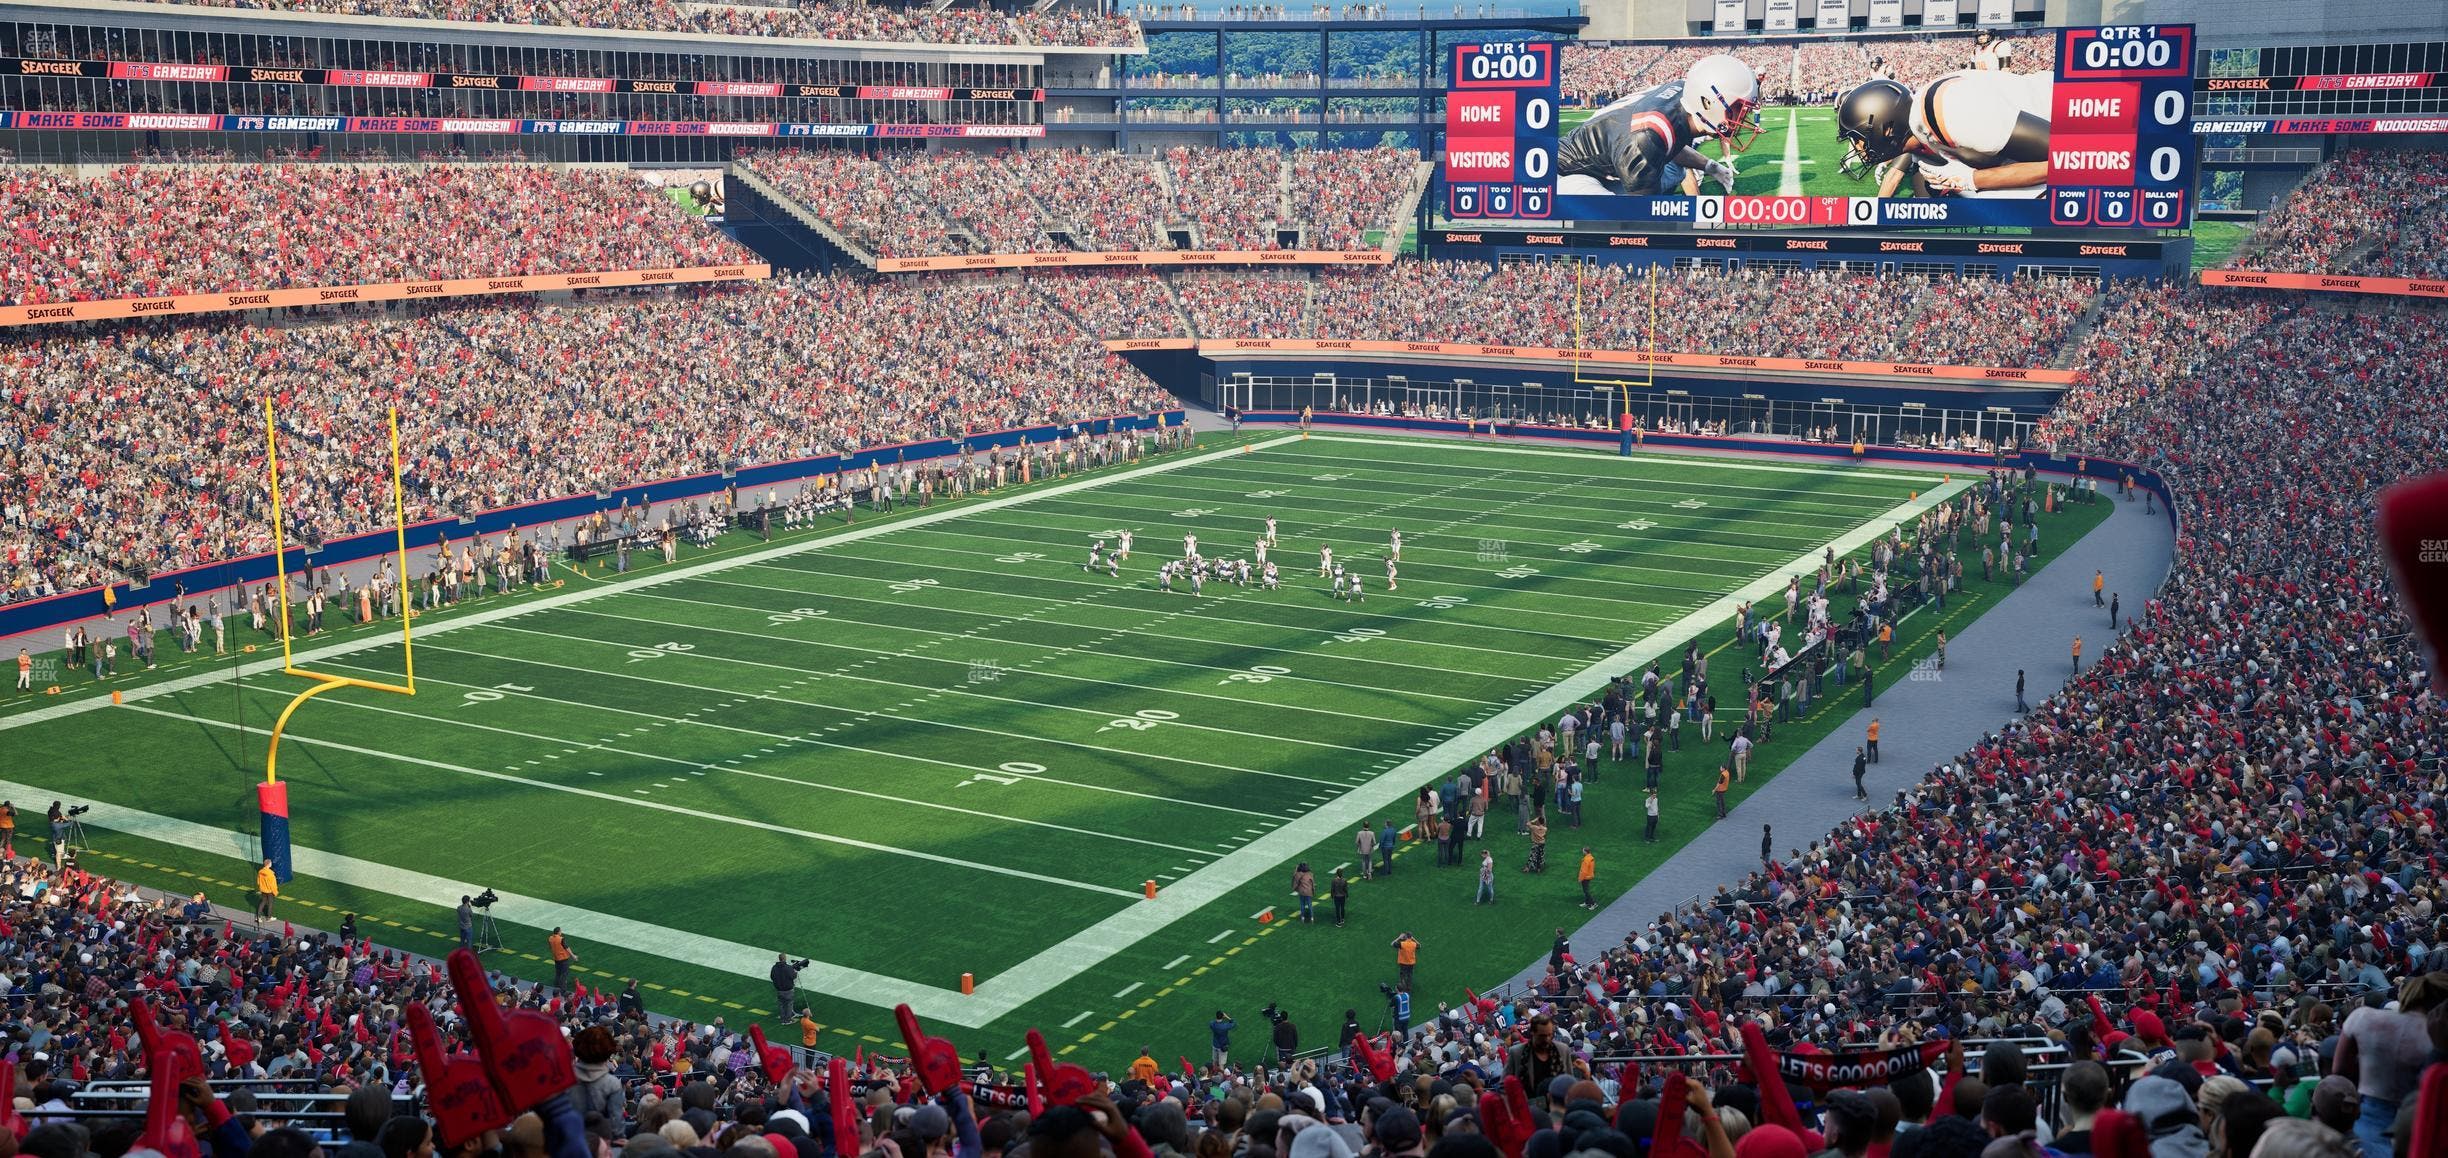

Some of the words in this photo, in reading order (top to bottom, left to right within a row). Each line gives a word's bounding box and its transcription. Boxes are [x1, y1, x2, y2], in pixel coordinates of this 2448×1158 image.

[2101, 27, 2140, 40] QTR
[2146, 26, 2156, 38] 1
[1483, 43, 1514, 54] QTR
[1518, 42, 1525, 53] 1
[2085, 39, 2171, 68] 0:00
[21, 61, 82, 76] SEATGEEK
[153, 66, 216, 79] GAMEDAY!
[1471, 54, 1537, 79] 0:00
[251, 69, 304, 82] SEATGEEK
[365, 73, 422, 85] GAMEDAY!
[452, 75, 499, 88] SEATGEEK
[2346, 75, 2418, 88] GAMEDAY!
[555, 79, 606, 90] GAMEDAY!
[632, 82, 677, 93] SEATGEEK
[727, 84, 775, 95] GAMEDAY!
[2208, 78, 2269, 90] SEATGEEK
[800, 86, 840, 96] SEATGEEK
[892, 88, 943, 98] GAMEDAY!
[971, 90, 1014, 99] SEATGEEK
[1460, 105, 1501, 122] HOME
[1526, 98, 1550, 129] 0
[2068, 98, 2121, 117] HOME
[2154, 90, 2185, 125] 0
[27, 114, 74, 127] MAKE
[82, 114, 124, 127] SOME
[237, 116, 265, 129] IT'S
[267, 117, 339, 131] GAMEDAY!
[358, 119, 398, 131] MAKE
[404, 119, 438, 131] SOME
[532, 120, 556, 133] IT'S
[559, 121, 620, 133] GAMEDAY!
[2287, 120, 2330, 132] MAKE
[2334, 120, 2371, 131] SOME
[636, 123, 670, 133] MAKE
[675, 123, 706, 133] SOME
[788, 124, 810, 135] IT'S
[812, 125, 868, 136] GAMEDAY!
[886, 125, 921, 135] MAKE
[927, 126, 961, 136] SOME
[2191, 121, 2267, 133] GAMEDAY!
[1449, 151, 1510, 168] VISITORS
[1525, 147, 1549, 178] 0
[2052, 151, 2131, 170] VISITORS
[2150, 146, 2181, 182] 0
[2145, 191, 2166, 199] BALL
[1460, 195, 1473, 211] 0
[1494, 195, 1507, 211] 0
[1528, 196, 1541, 211] 0
[1821, 197, 1839, 206] QRT
[1651, 201, 1690, 216] HOME
[1702, 198, 1719, 219] 0
[1729, 198, 1806, 221] 00:00
[1826, 206, 1833, 221] 1
[1855, 200, 1872, 221] 0
[1884, 202, 1948, 220] VISITORS
[2063, 201, 2079, 218] 0
[2107, 201, 2124, 218] 0
[2153, 201, 2169, 219] 0
[1446, 233, 1482, 243] SEATGEEK
[1526, 235, 1564, 245] SEATGEEK
[1610, 236, 1648, 247] SEATGEEK
[1696, 238, 1736, 248] SEATGEEK
[1786, 239, 1828, 250] SEATGEEK
[1880, 241, 1923, 252] SEATGEEK
[1978, 243, 2023, 254] SEATGEEK
[2079, 245, 2127, 256] SEATGEEK
[965, 257, 996, 265] SEATGEEK
[1034, 255, 1068, 263] SEATGEEK
[1104, 254, 1138, 262] SEATGEEK
[1181, 253, 1216, 261] SEATGEEK
[1260, 253, 1296, 261] SEATGEEK
[1344, 253, 1381, 261] SEATGEEK
[899, 260, 929, 268] SEATGEEK
[641, 272, 674, 281] SEATGEEK
[714, 268, 745, 277] SEATGEEK
[488, 279, 523, 290] SEATGEEK
[567, 275, 600, 286] SEATGEEK
[2224, 274, 2268, 284] SEATGEEK
[2321, 278, 2360, 288] SEATGEEK
[406, 284, 444, 295] SEATGEEK
[2409, 283, 2445, 293] SEATGEEK
[228, 294, 270, 306] SEATGEEK
[320, 289, 359, 300] SEATGEEK
[132, 300, 176, 313] SEATGEEK
[27, 306, 75, 320] SEATGEEK
[1126, 341, 1160, 349] SEATGEEK
[1235, 340, 1271, 348] SEATGEEK
[1316, 341, 1351, 349] SEATGEEK
[1407, 343, 1440, 352] SEATGEEK
[1481, 346, 1515, 355] SEATGEEK
[1720, 357, 1757, 367] SEATGEEK
[1805, 361, 1843, 371] SEATGEEK
[1893, 365, 1933, 375] SEATGEEK
[1985, 369, 2027, 379] SEATGEEK
[1416, 595, 1468, 609] 50
[768, 607, 829, 623] 30
[1333, 628, 1386, 642] 40
[627, 641, 696, 659] 20
[1229, 665, 1292, 684] 30
[464, 682, 535, 702] 10
[1109, 709, 1180, 731] 20
[973, 761, 1047, 786] 10
[1780, 1054, 1824, 1081] LET'S
[1827, 1049, 1921, 1082] GOOOOO!!!
[973, 1086, 1006, 1105] LET'S
